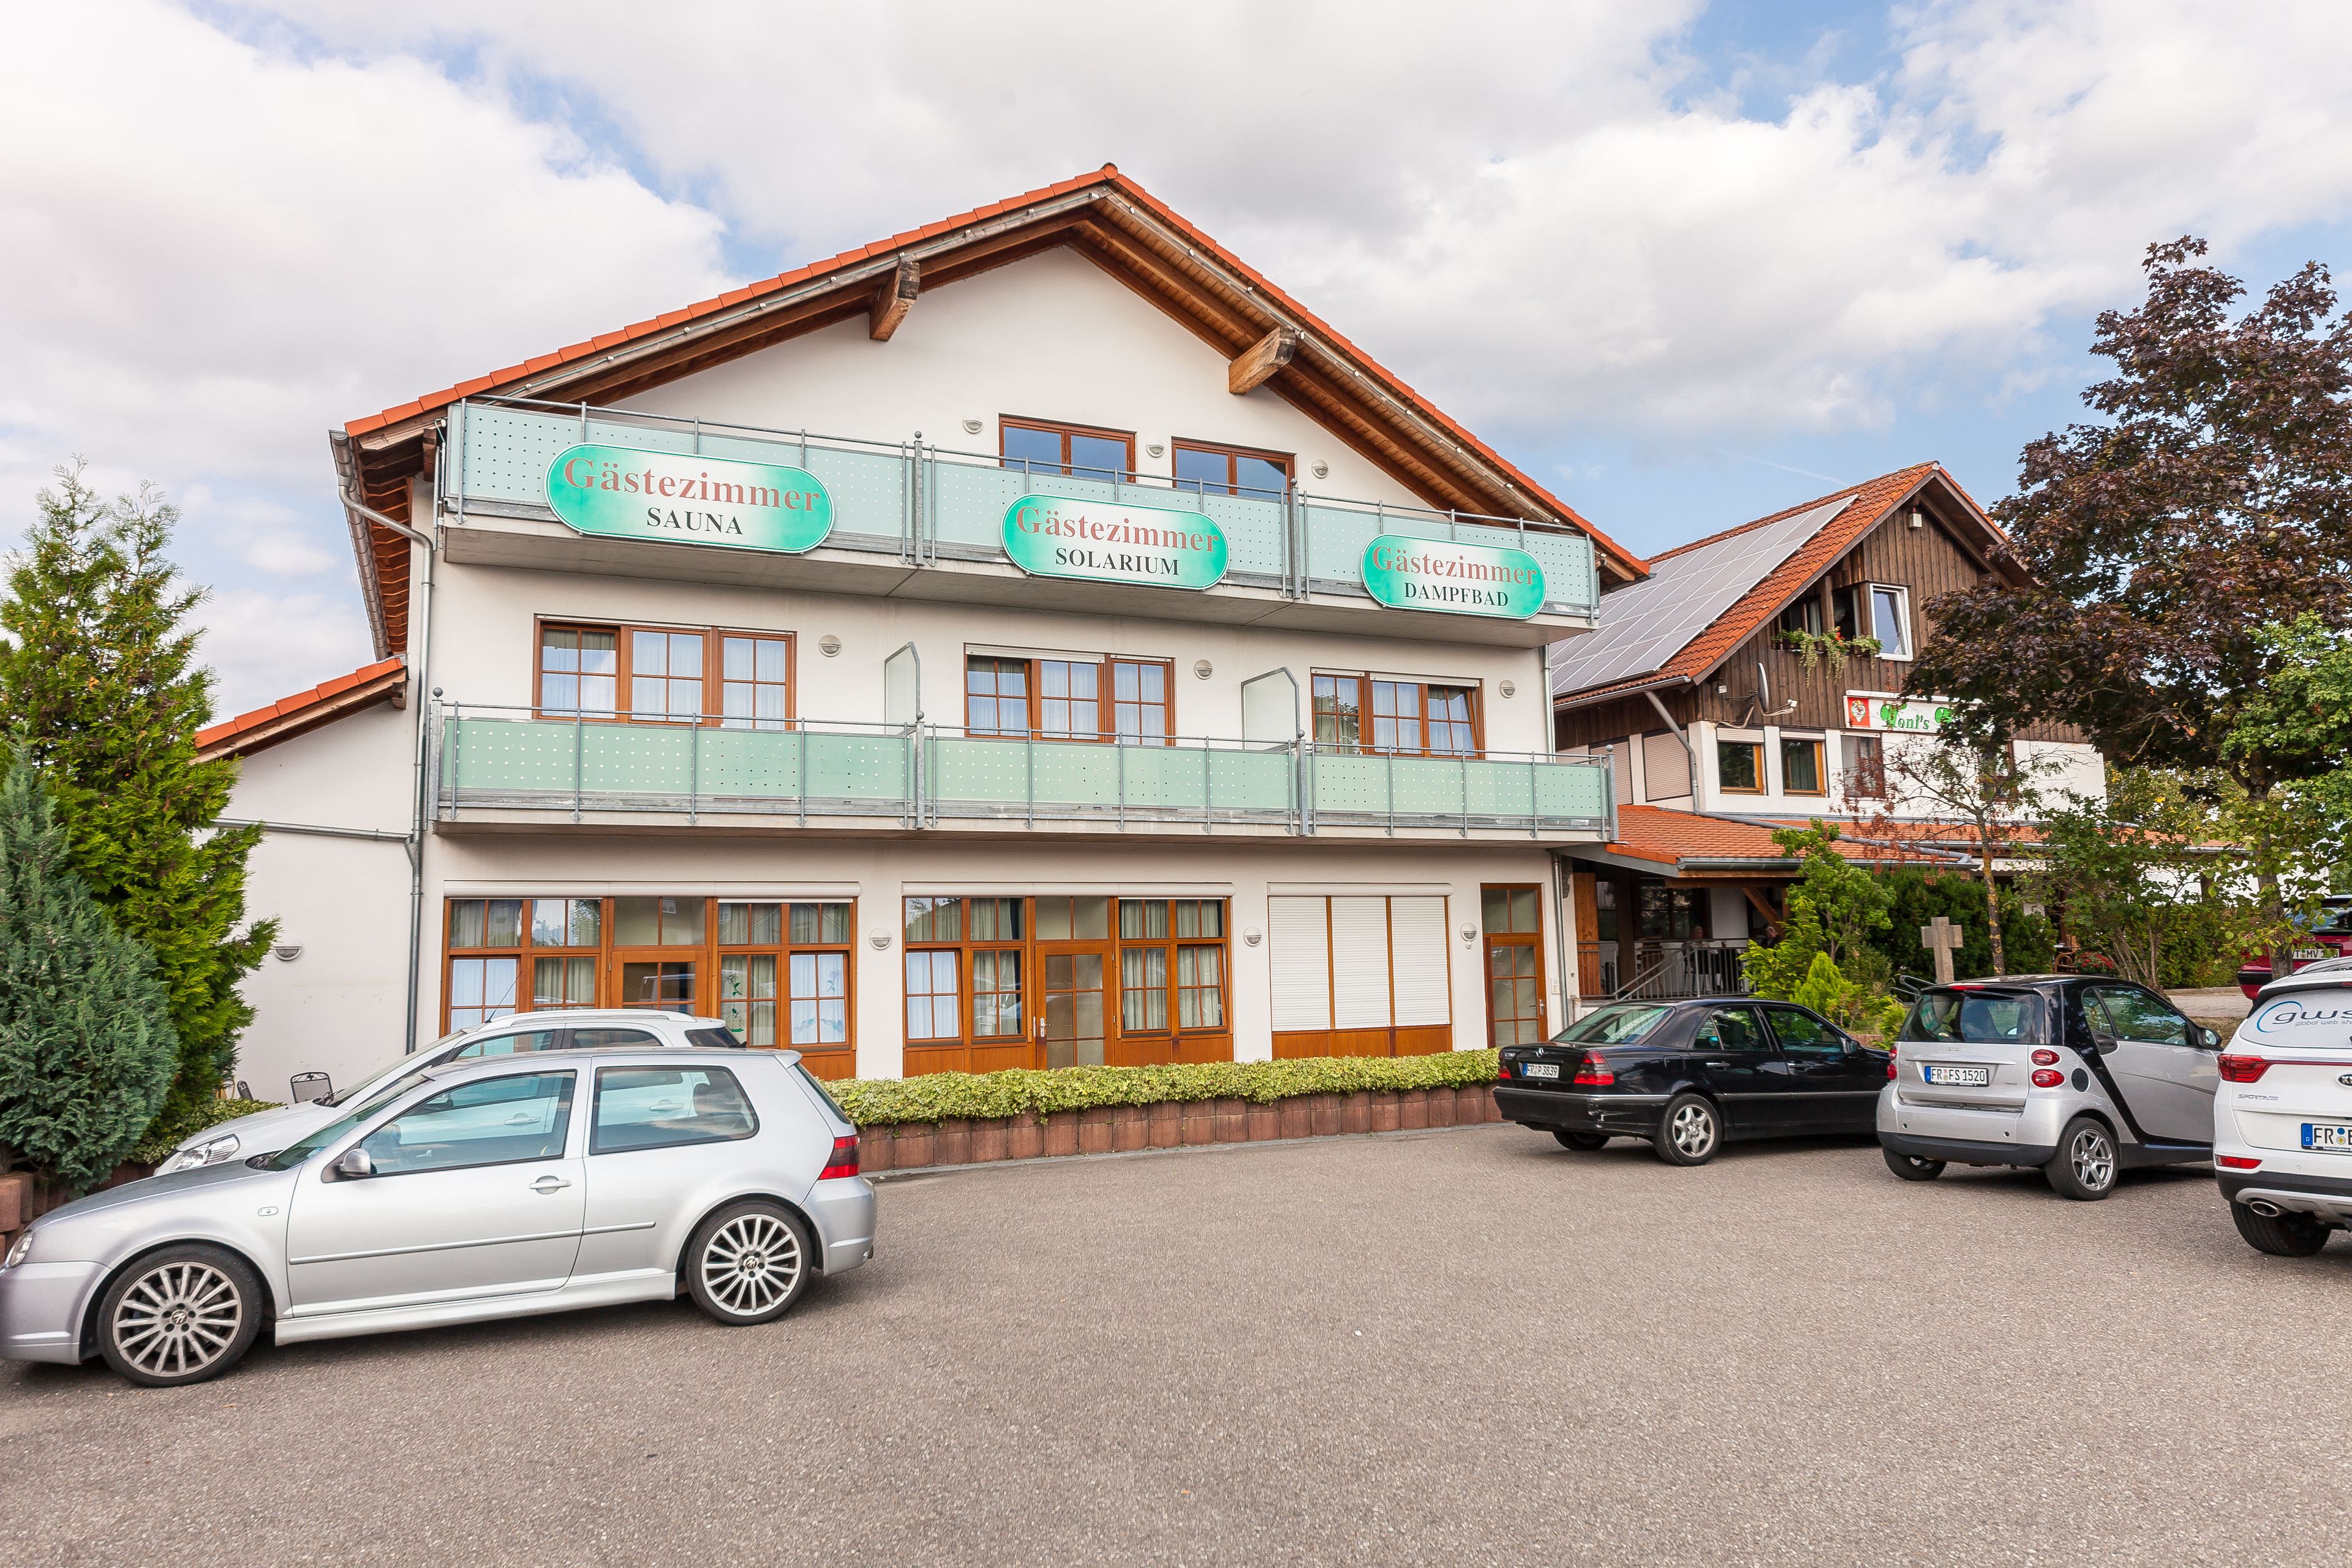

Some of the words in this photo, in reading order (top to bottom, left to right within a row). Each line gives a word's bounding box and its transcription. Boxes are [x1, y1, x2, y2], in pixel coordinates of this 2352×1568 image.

[565, 458, 820, 511] Gästezimmer
[647, 508, 743, 535] SAUNA
[1017, 507, 1219, 552] Gästezimmer
[1056, 548, 1179, 575] SOLARIUM
[1373, 546, 1537, 585] Gästezimmer
[1404, 582, 1508, 606] DAMPFBAD
[1932, 1069, 1942, 1080] FR
[1949, 1069, 1960, 1080] FS
[1962, 1070, 1985, 1082] 1520
[2313, 1128, 2334, 1144] FR
